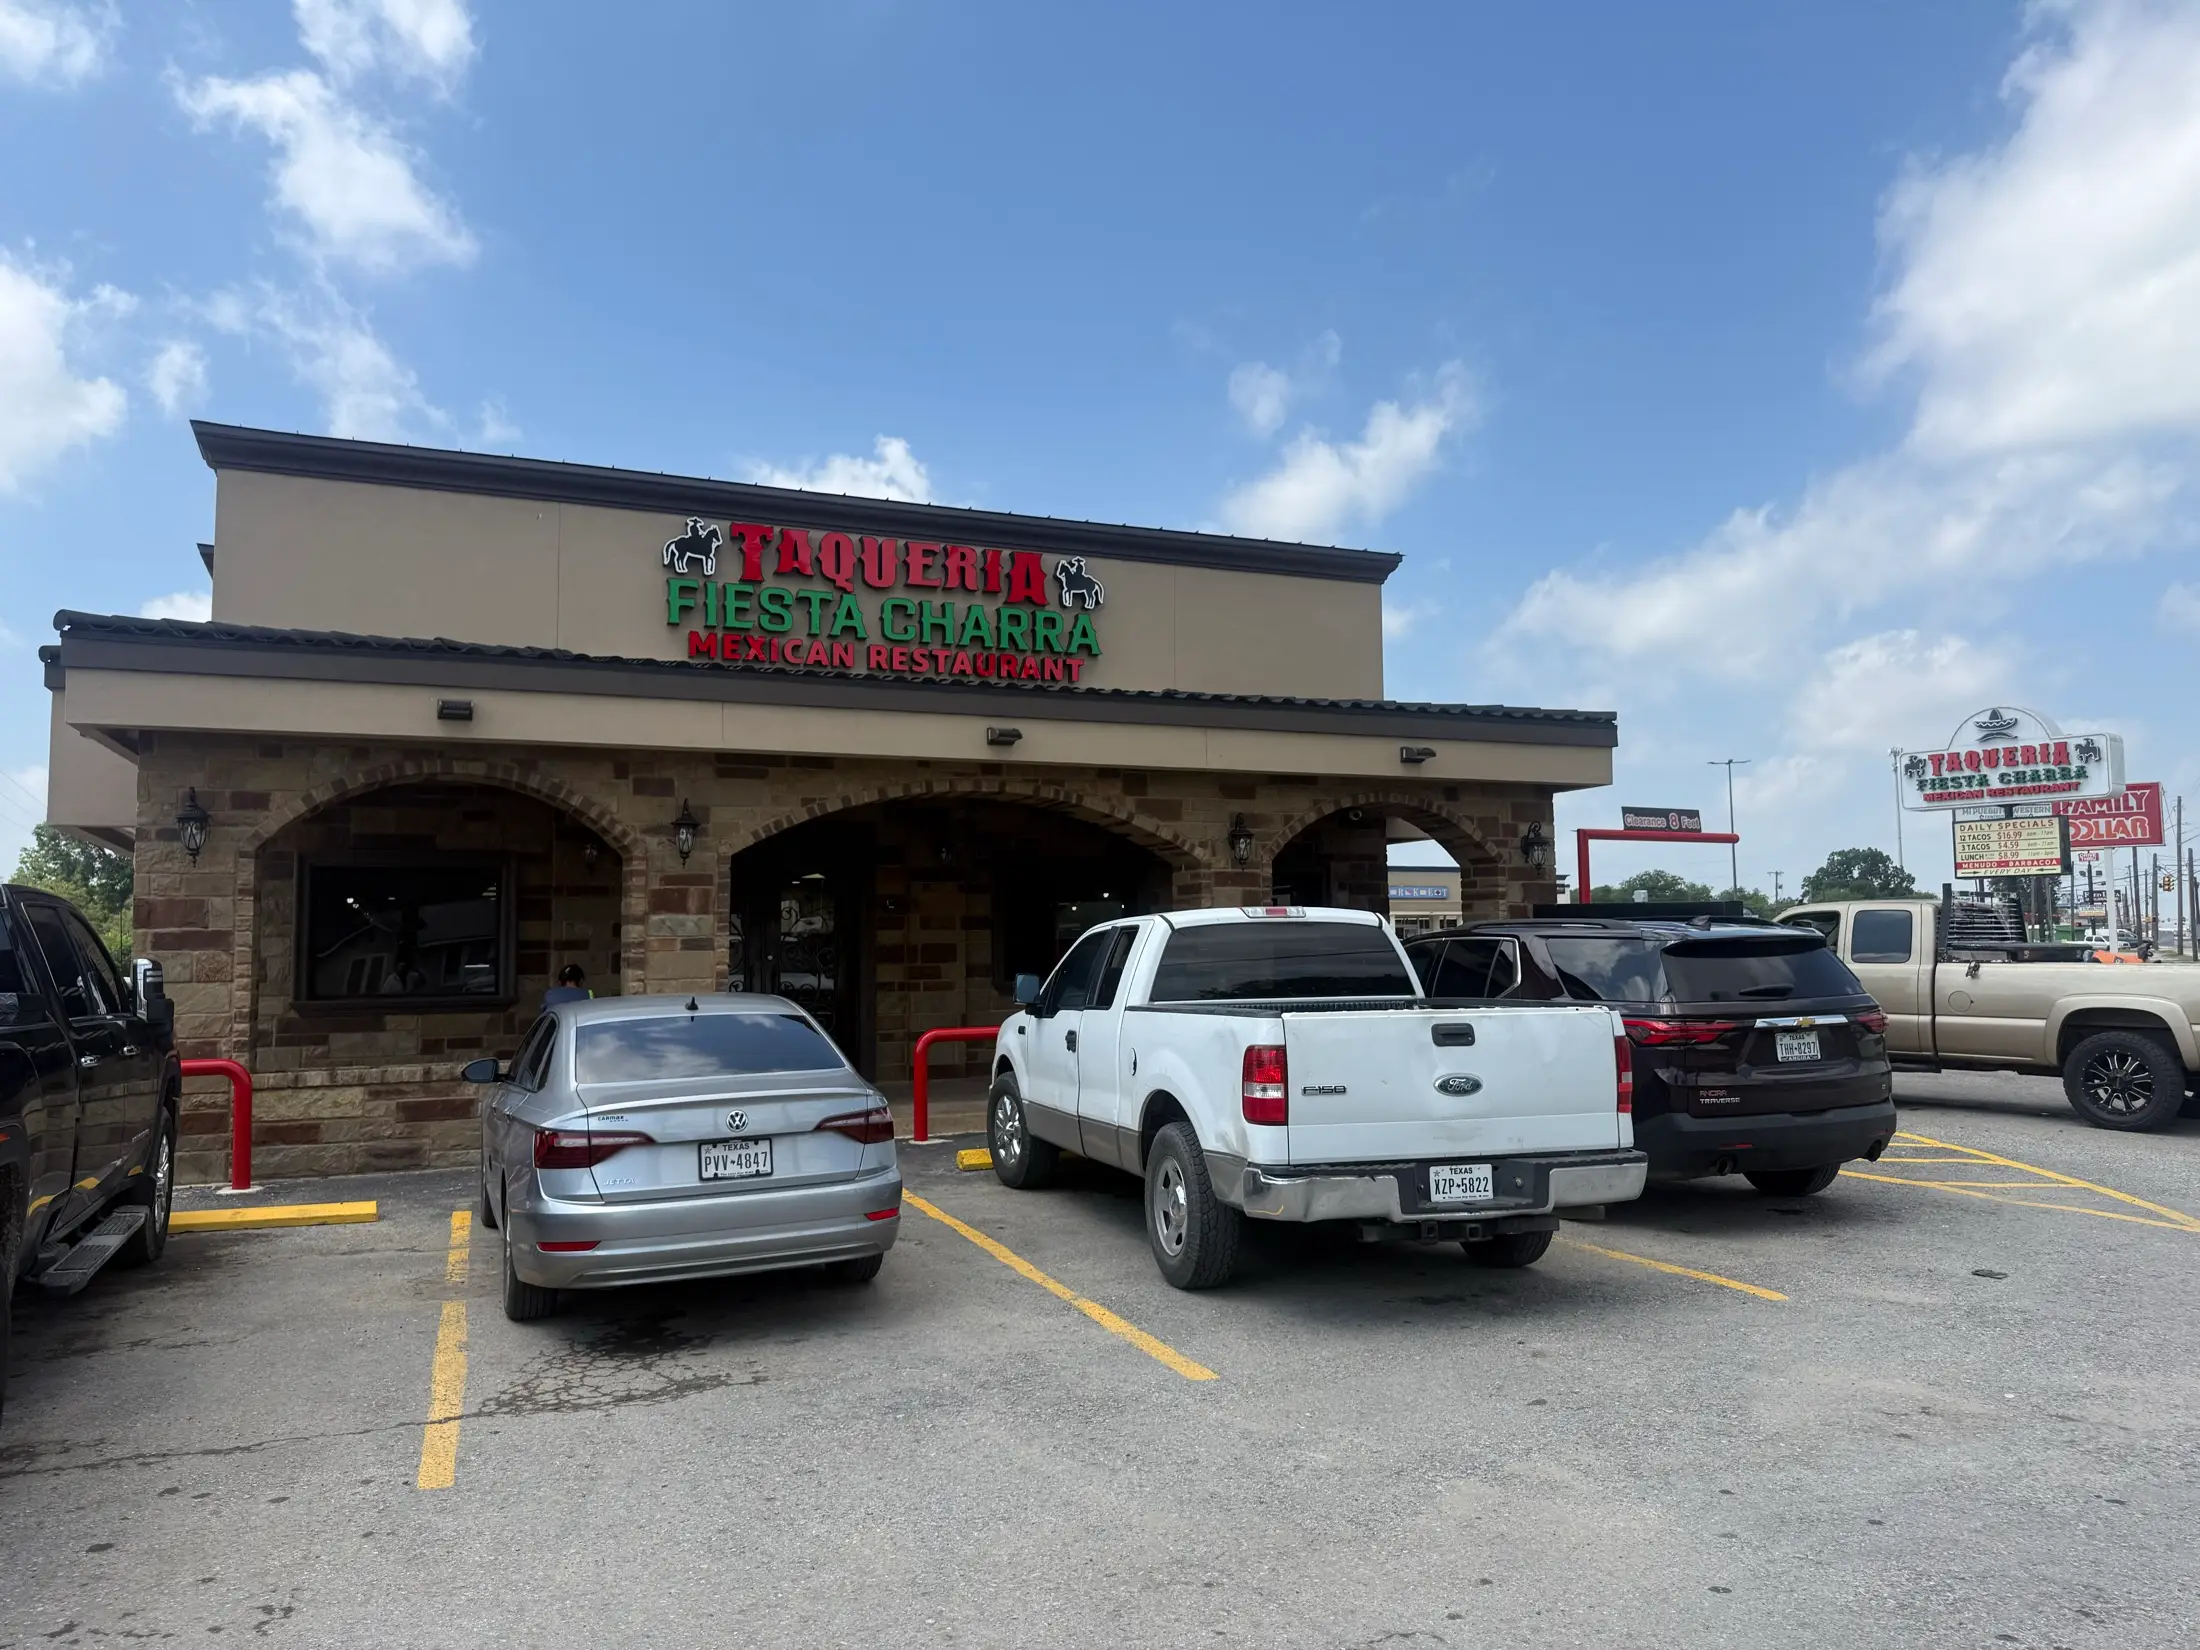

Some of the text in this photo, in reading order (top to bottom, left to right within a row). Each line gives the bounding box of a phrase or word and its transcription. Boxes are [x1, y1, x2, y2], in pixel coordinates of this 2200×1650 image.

[730, 521, 1049, 605] TAQUERIA
[666, 577, 1103, 655] FIESTA CHARRA
[688, 630, 1085, 682] MEXICAN RESTAURANT
[1927, 741, 2071, 777] TAQUERIA
[1916, 765, 2089, 792] FIESTA CHARRA
[1922, 781, 2081, 803] MEXICAN RESTAURANT
[2013, 805, 2051, 814] WESTERN
[2060, 789, 2151, 816] FAMILY
[1624, 812, 1701, 830] Clearance 8 Feet
[1960, 819, 2054, 832] DAILY SPECIALS
[1968, 833, 1991, 841] TACOS
[1997, 831, 2022, 840] $16.99
[1967, 843, 1990, 851] TACOS
[1998, 841, 2019, 850] $4.59
[1960, 853, 1985, 861] LUNCH
[1998, 851, 2019, 860] $8.99
[1447, 1077, 1473, 1091] Ford
[722, 1143, 750, 1152] TEXAS
[1449, 1167, 1473, 1175] TEXAS
[603, 1178, 636, 1186] JETTA
